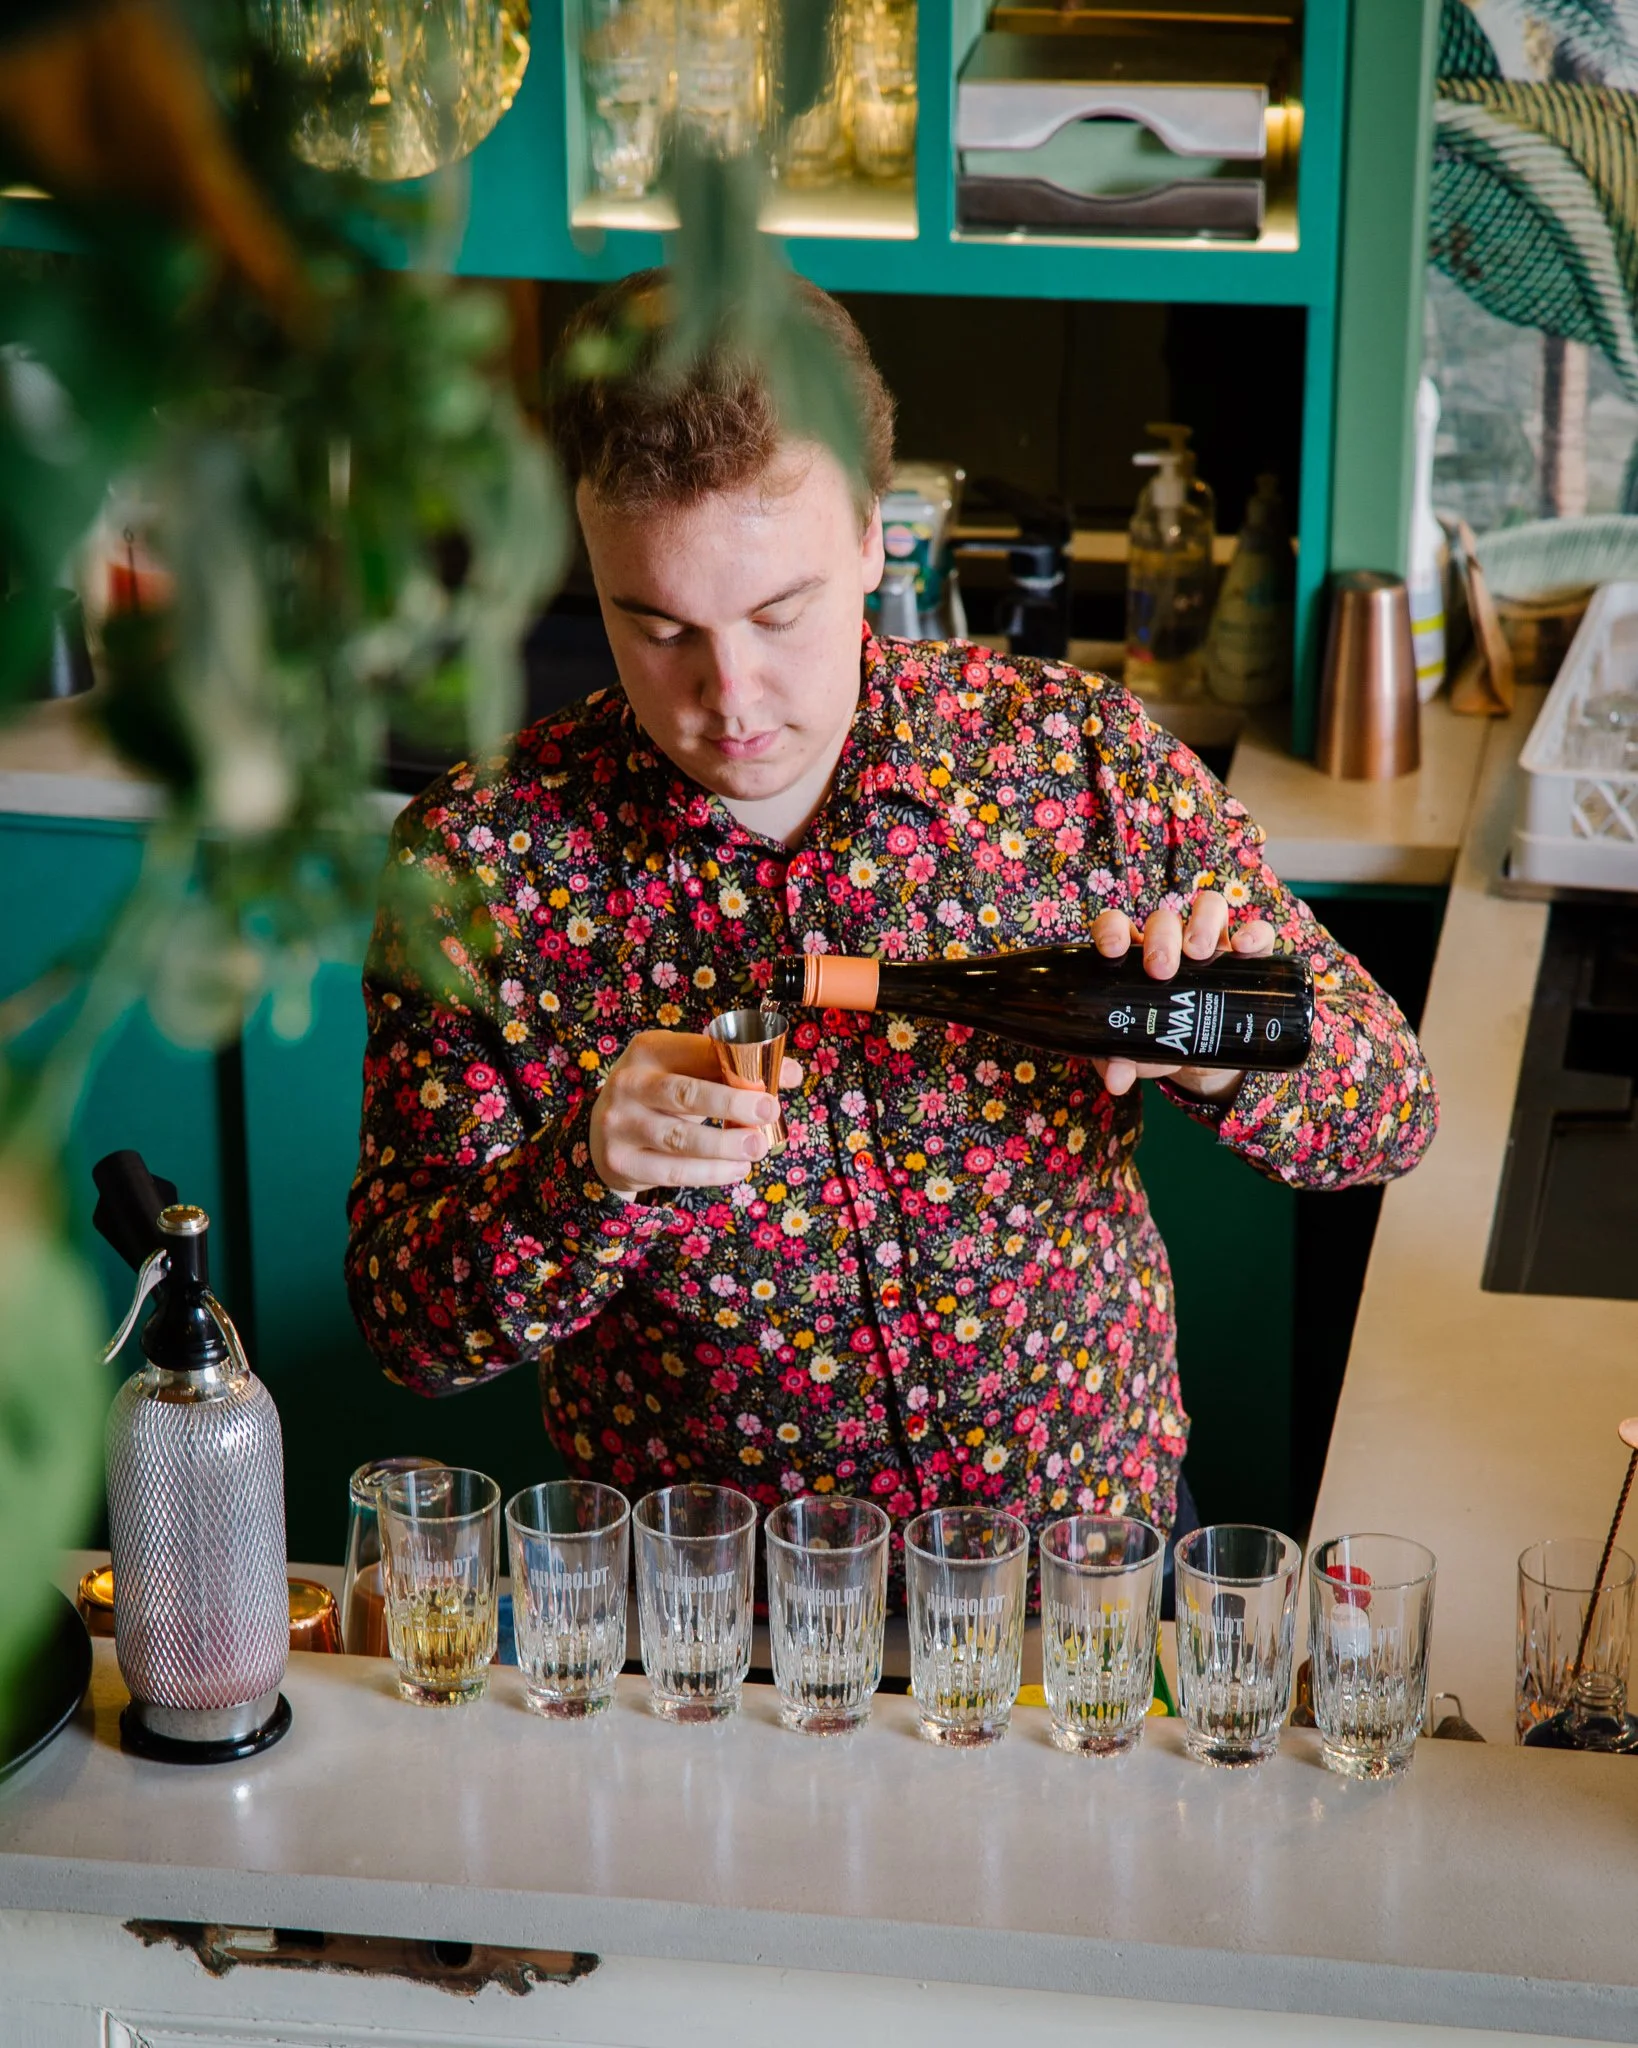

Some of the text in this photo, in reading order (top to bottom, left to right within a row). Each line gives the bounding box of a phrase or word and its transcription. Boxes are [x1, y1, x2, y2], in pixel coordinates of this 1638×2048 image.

[1155, 990, 1196, 1056] AVAA
[1198, 992, 1213, 1054] THE BETTER SOUR
[1243, 1013, 1254, 1044] ORGANIC
[393, 1555, 473, 1578] HUMBOLDT
[530, 1566, 609, 1590] HUMBOLDT
[655, 1570, 736, 1593] HUMBOLDT
[784, 1582, 863, 1606] HUMBOLDT
[926, 1591, 1007, 1616] HUMBOLDT
